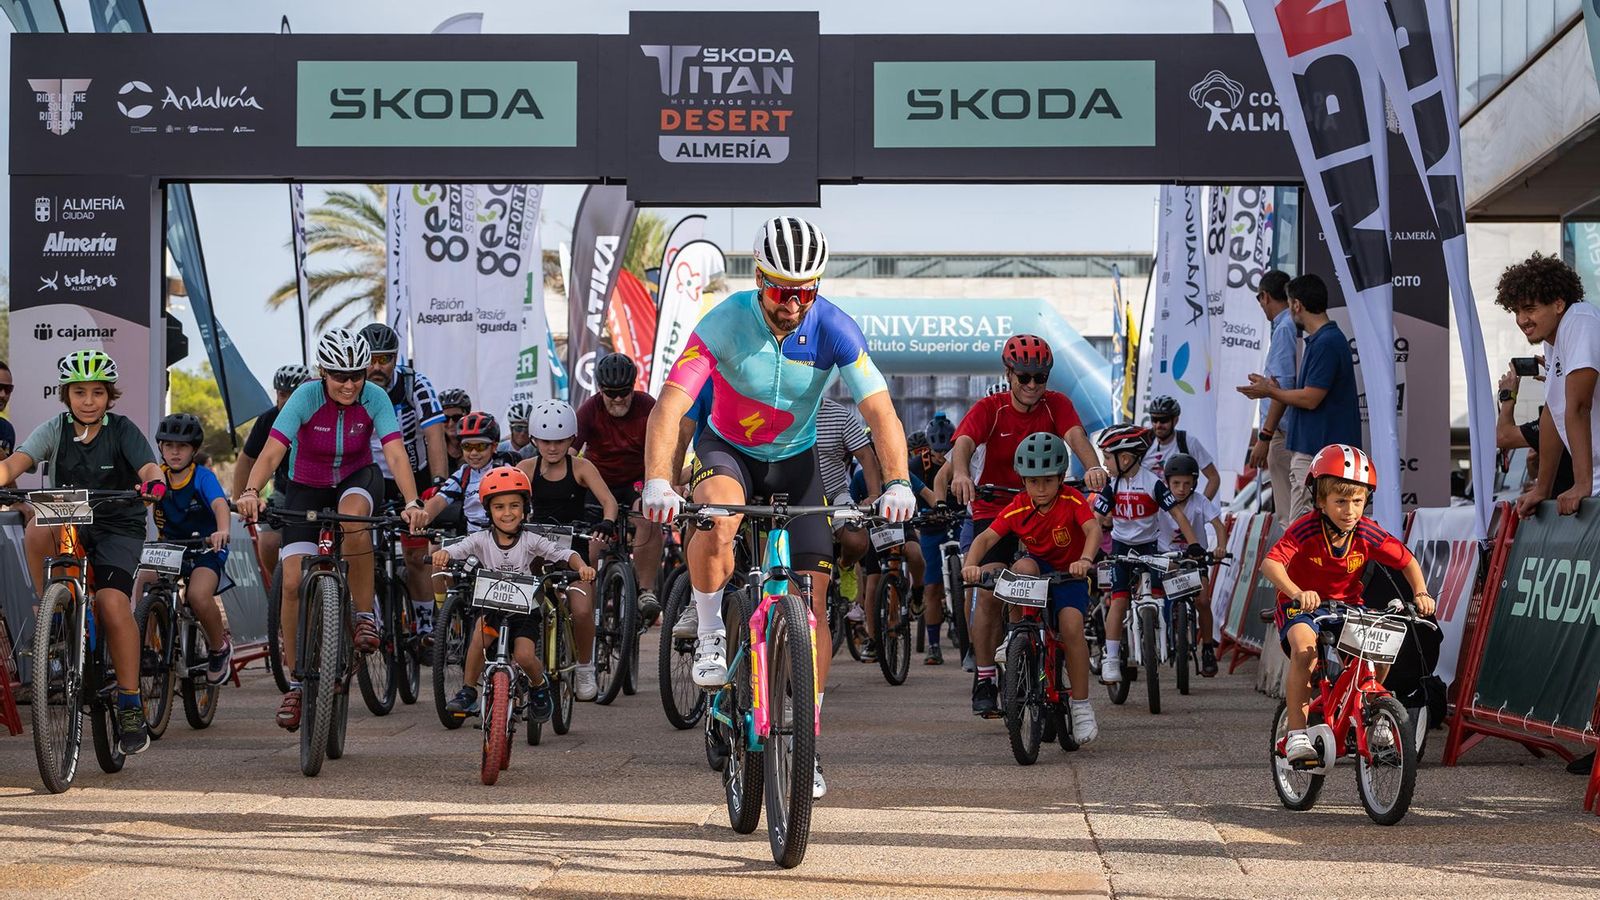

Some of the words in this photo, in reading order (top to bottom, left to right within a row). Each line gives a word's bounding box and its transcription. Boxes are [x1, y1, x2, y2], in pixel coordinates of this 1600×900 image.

[703, 48, 794, 63] SKODA
[640, 45, 794, 96] TITAN
[161, 86, 264, 111] Andalucía
[329, 88, 544, 119] SKODA
[906, 88, 1123, 120] SKODA
[1249, 92, 1281, 107] COS
[661, 109, 794, 131] DESERT
[676, 139, 771, 158] ALMERÍA
[63, 195, 125, 210] ALMERÍA
[62, 211, 95, 220] CIUDAD
[43, 231, 118, 252] Almería
[1394, 230, 1436, 240] ALMERÍA
[64, 268, 118, 287] sabores
[430, 297, 464, 310] Pasión
[417, 312, 473, 325] Asegurada
[57, 324, 117, 341] cajamar
[867, 339, 906, 352] tituto
[909, 339, 968, 355] Superior
[972, 339, 991, 352] de
[145, 549, 173, 557] FAMILY
[148, 556, 167, 565] RIDE
[225, 551, 259, 587] ODA
[489, 581, 519, 594] FAMILY
[1172, 576, 1191, 586] FAMILY
[492, 591, 514, 602] RIDE
[1010, 588, 1031, 597] RIDE
